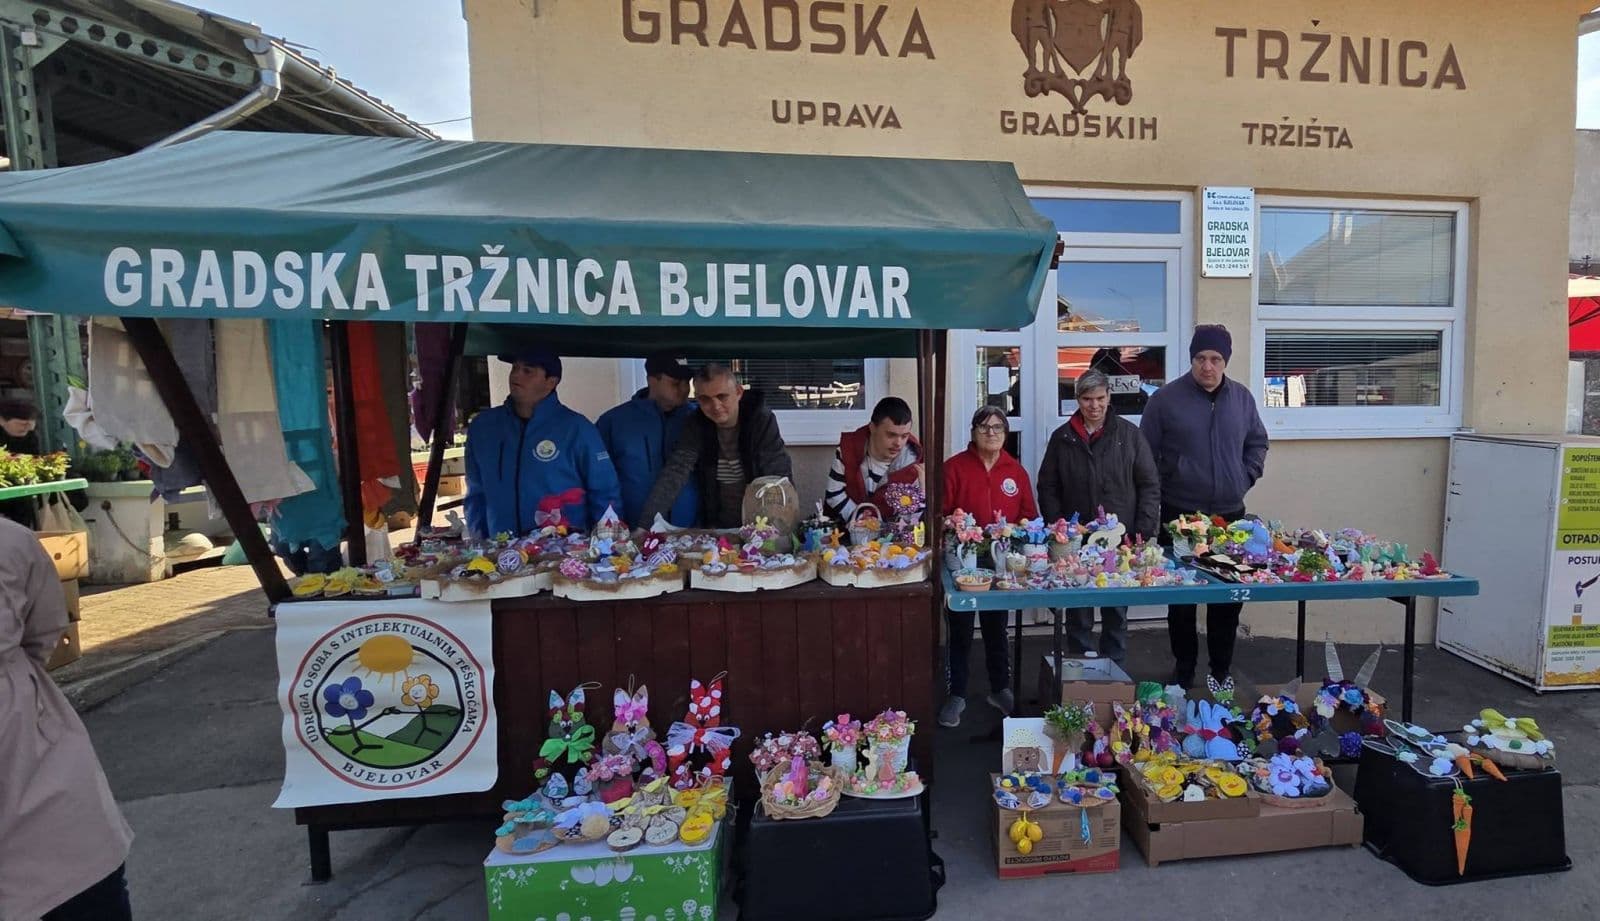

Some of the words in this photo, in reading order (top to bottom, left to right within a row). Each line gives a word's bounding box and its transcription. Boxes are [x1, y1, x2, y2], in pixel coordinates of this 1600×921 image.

[622, 0, 936, 59] GRADSKA
[1215, 19, 1467, 90] TRŽNICA
[771, 99, 902, 129] UPRAVA
[1000, 110, 1158, 141] GRADSKIH
[1241, 116, 1353, 149] TRŽIŠTA
[1207, 221, 1249, 231] GRADSKA
[1209, 232, 1247, 244] TRŽNICA
[1206, 247, 1250, 257] BJELOVAR
[104, 246, 390, 310] GRADSKA
[405, 244, 641, 315] TRŽNICA
[660, 261, 911, 318] BJELOVAR
[1563, 534, 1600, 544] OTPAD
[331, 640, 340, 650] S
[340, 621, 456, 659] INTELEKTUALNIM
[305, 649, 332, 689] OSOBA
[455, 657, 478, 734] TEŠKOĆAMA
[299, 692, 319, 743] UDRUGA
[342, 759, 444, 784] BJELOVAR
